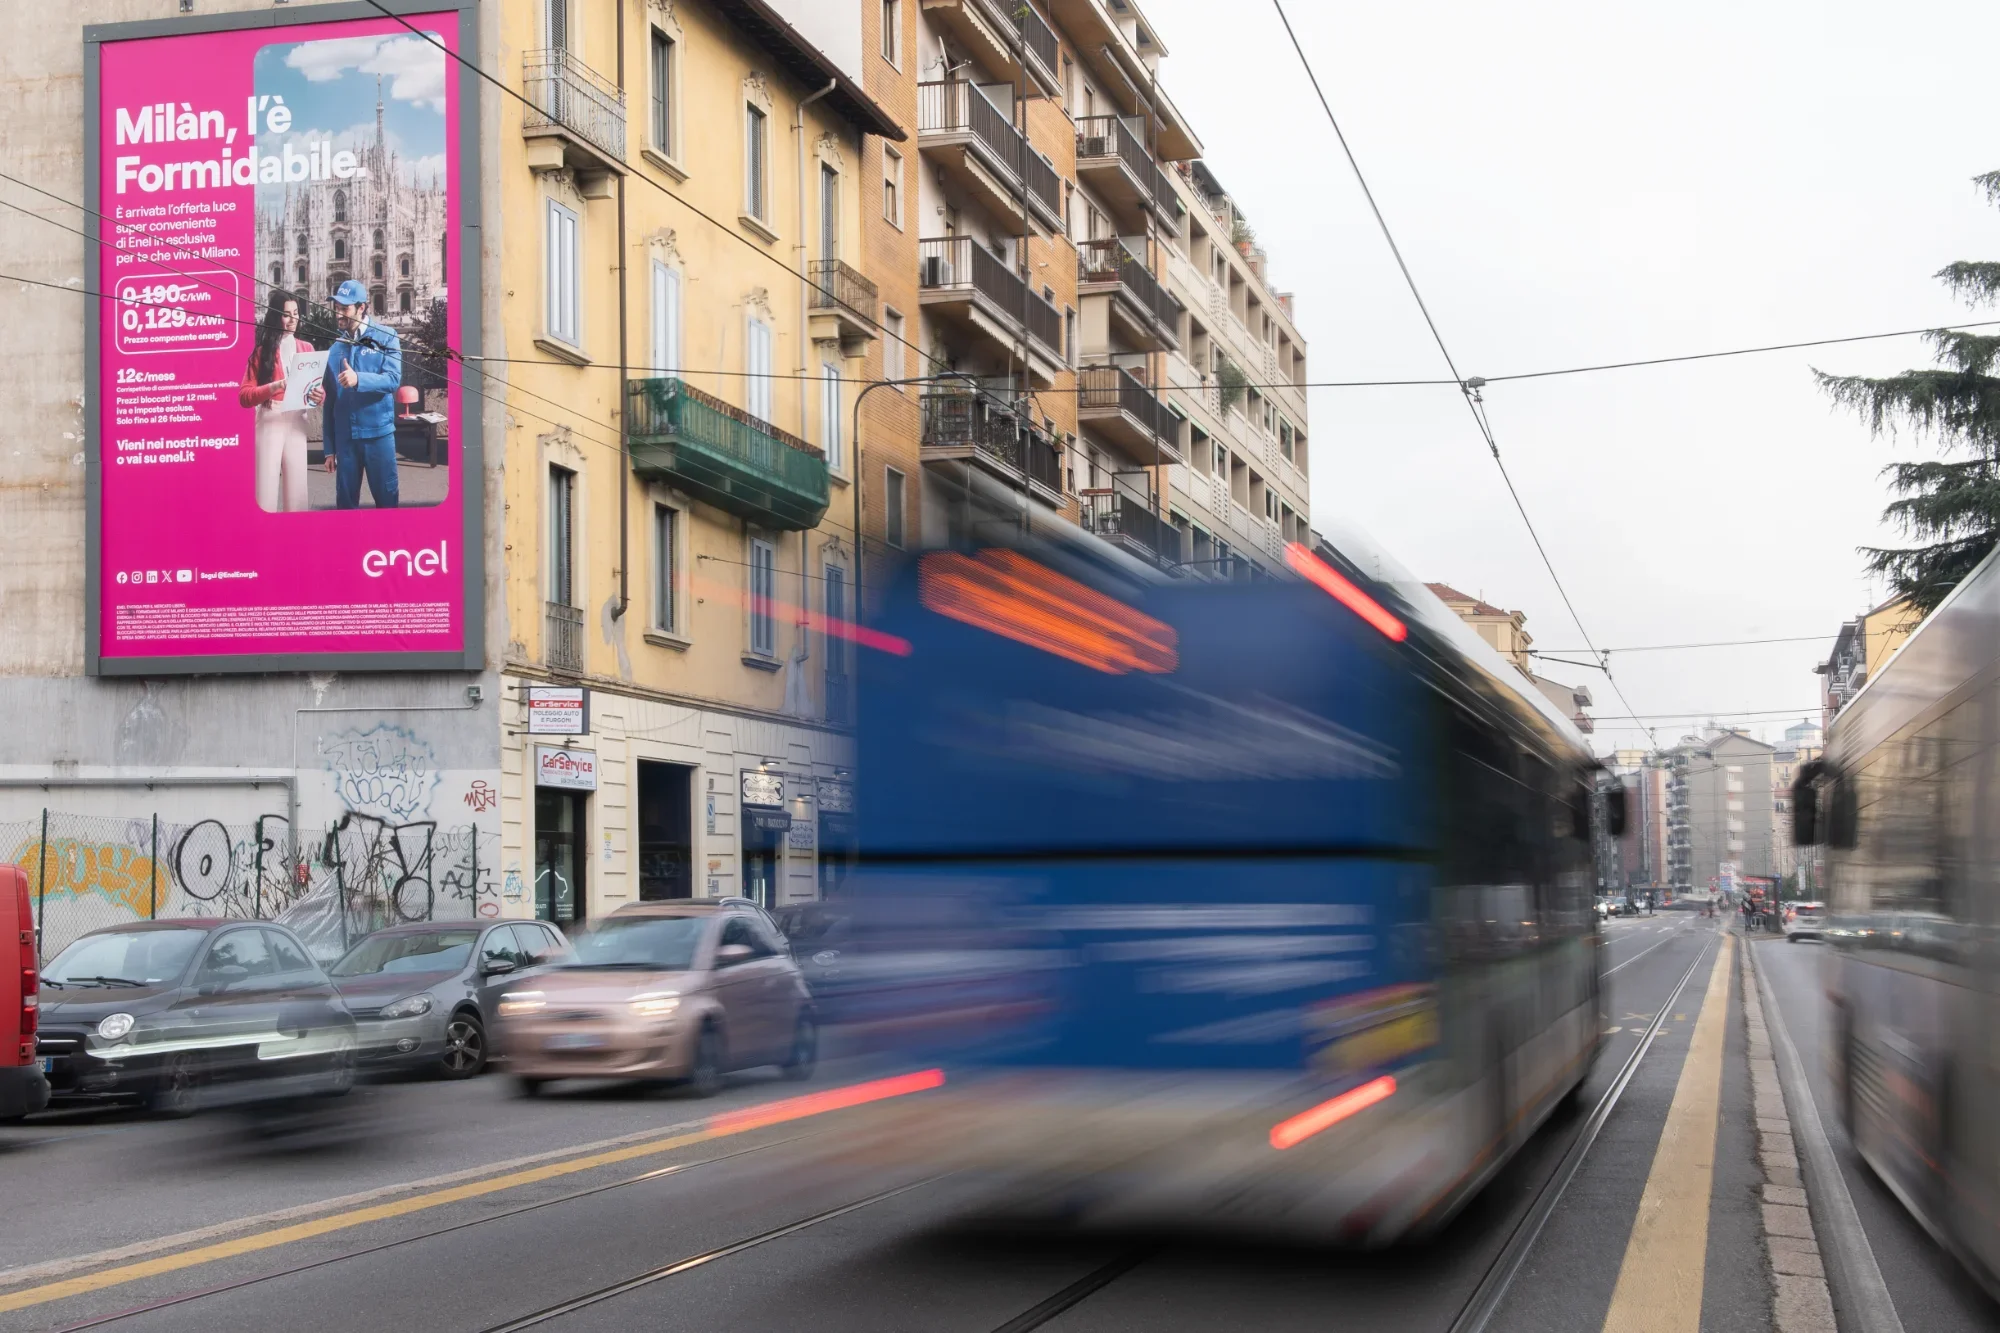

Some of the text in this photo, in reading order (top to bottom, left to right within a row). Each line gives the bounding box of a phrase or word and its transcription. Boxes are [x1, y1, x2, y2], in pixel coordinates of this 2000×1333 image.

[116, 102, 238, 145] Milàn,
[116, 141, 367, 194] Formidabile.
[116, 201, 236, 218] È arrivata l'offerta luce
[116, 217, 216, 235] super conveniente
[116, 232, 215, 248] di Enel in esclusiva
[116, 246, 240, 266] per te che vivi a Milano.
[123, 331, 228, 344] Prezzo componente energia.
[116, 396, 139, 404] Prezzi
[140, 394, 171, 403] bloccati
[172, 395, 185, 403] per
[186, 393, 196, 401] 12
[134, 405, 164, 415] imposte
[165, 404, 194, 413] escluse.
[116, 413, 202, 425] Solo fino al 26 febbraio.
[116, 434, 239, 451] Vieni nei nostri negozi
[116, 450, 195, 465] o vai su enel.it
[362, 540, 448, 577] enel
[200, 572, 217, 580] Segui
[543, 755, 593, 772] CarService
